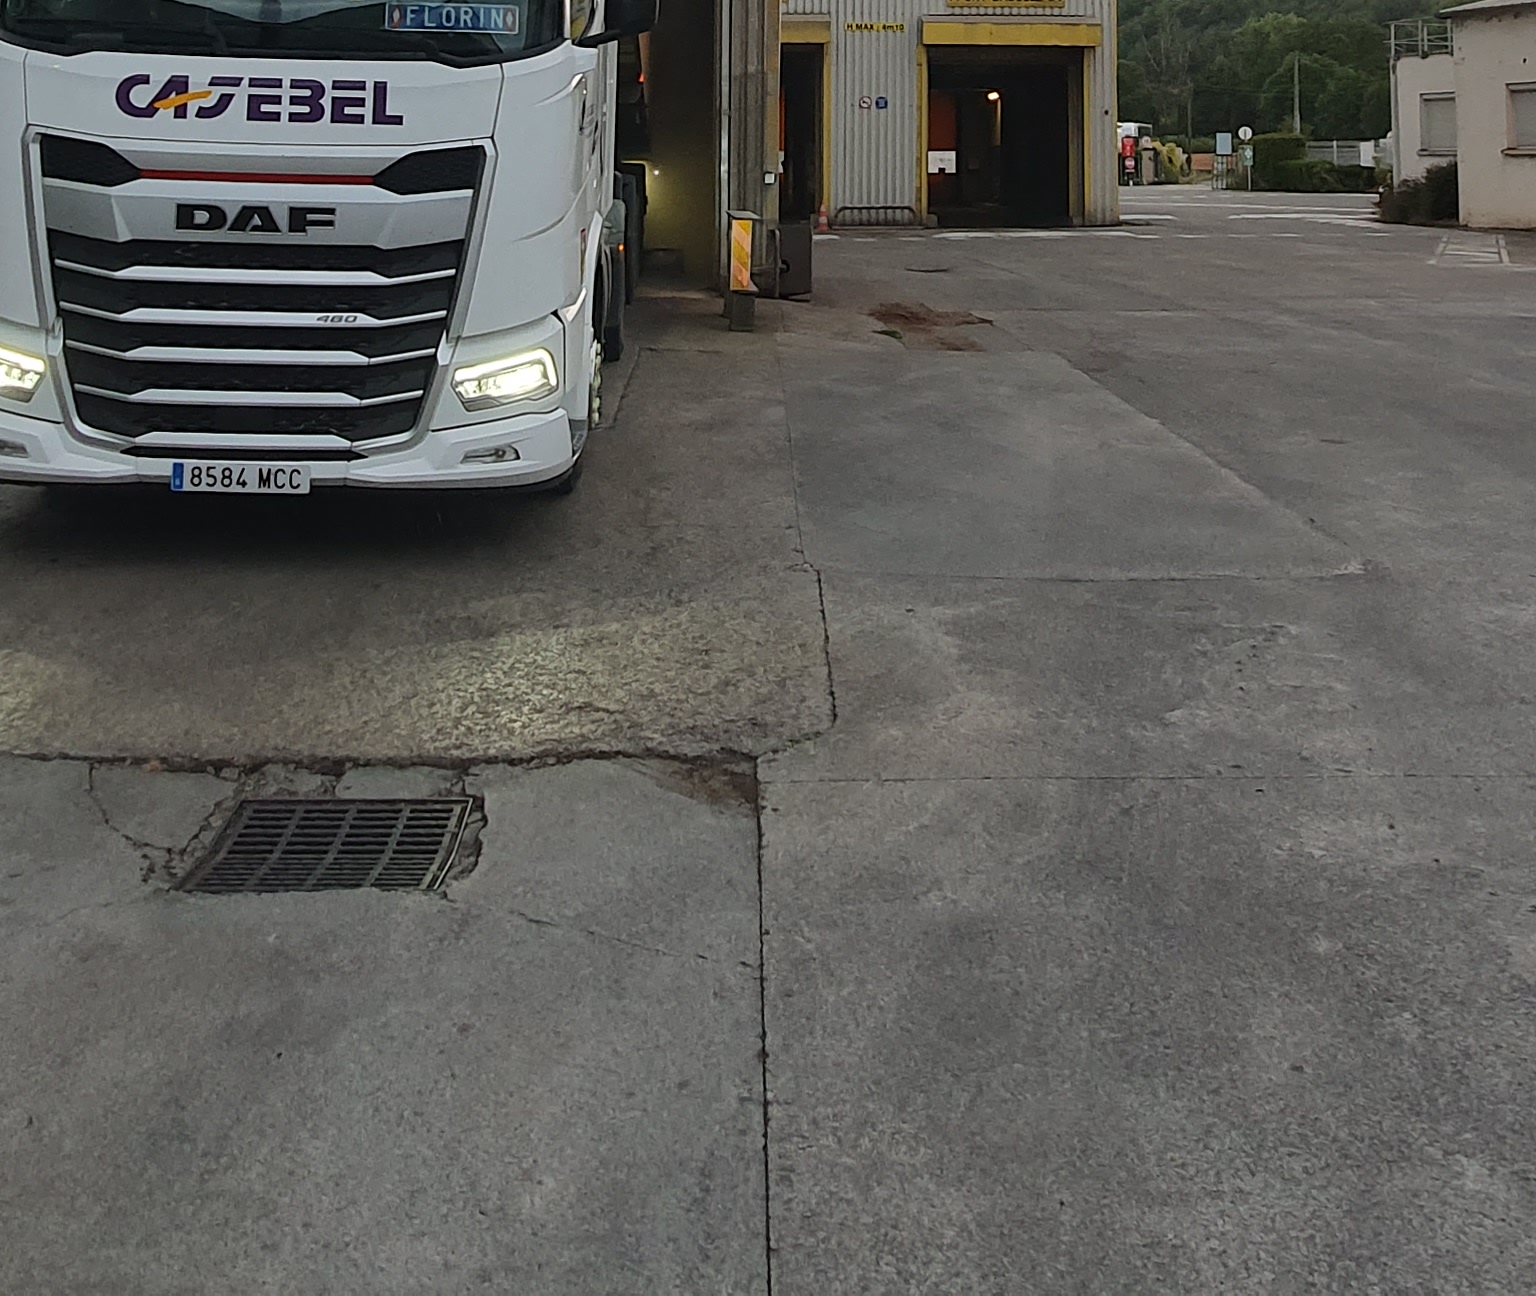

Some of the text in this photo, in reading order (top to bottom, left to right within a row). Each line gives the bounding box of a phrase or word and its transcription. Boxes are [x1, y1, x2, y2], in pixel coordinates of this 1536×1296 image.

[406, 6, 504, 29] FLORIN
[175, 203, 337, 236] DAF
[190, 466, 302, 490] 8584 MCC
